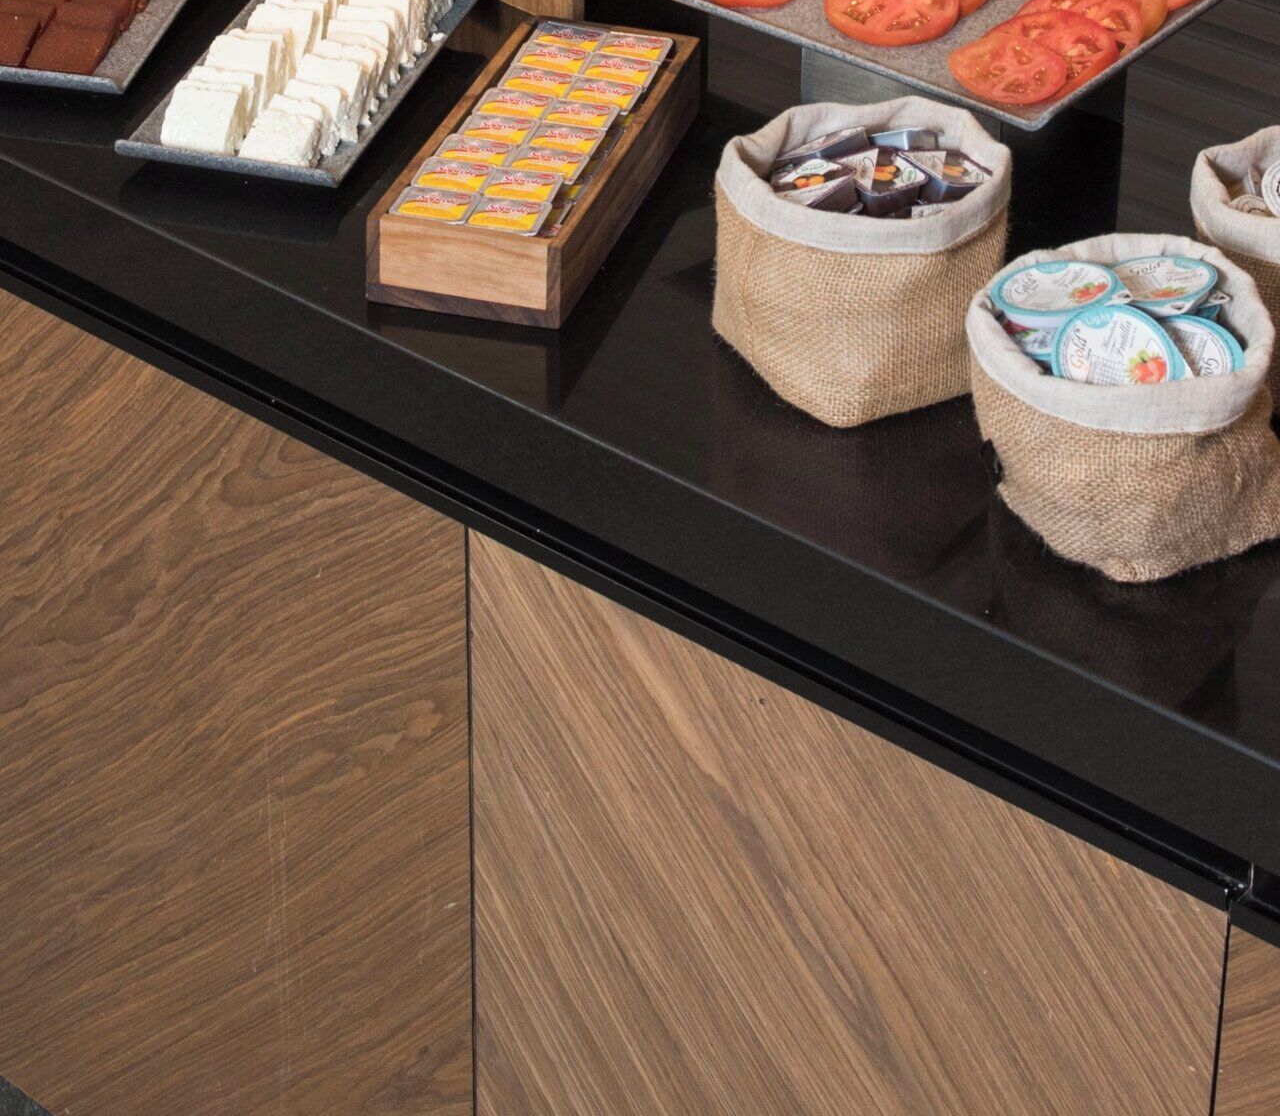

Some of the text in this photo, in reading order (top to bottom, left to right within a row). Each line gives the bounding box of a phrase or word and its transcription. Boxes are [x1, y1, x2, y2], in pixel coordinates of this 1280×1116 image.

[552, 28, 589, 41] Soprole
[614, 38, 653, 49] Soprole
[535, 47, 574, 60] Soprole
[600, 59, 640, 71] Soprole
[520, 70, 560, 83] Soprole
[585, 82, 622, 96] Soprole
[498, 94, 536, 106] Soprole
[558, 103, 597, 116] Soprole
[480, 120, 519, 131] Soprole
[546, 129, 585, 140] Soprole
[457, 143, 497, 154] Soprole
[529, 151, 570, 163] Soprole
[438, 165, 477, 177] Soprole
[502, 174, 543, 186] Soprole
[419, 193, 458, 206] Soprole
[487, 203, 529, 215] Soprole
[1130, 262, 1161, 276] Gold
[1084, 309, 1112, 326] Light
[1113, 320, 1132, 358] Frutilla
[1070, 327, 1088, 372] Gold
